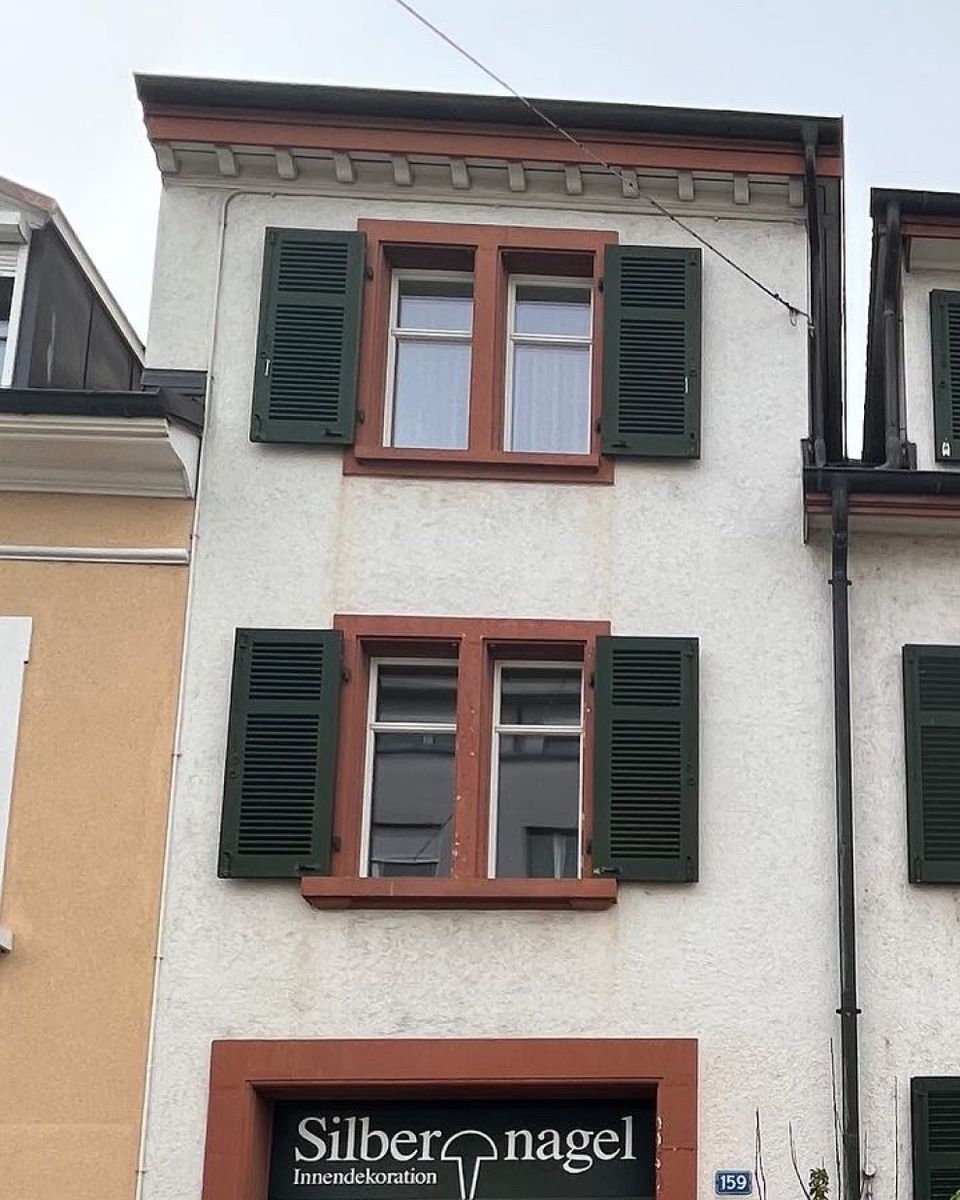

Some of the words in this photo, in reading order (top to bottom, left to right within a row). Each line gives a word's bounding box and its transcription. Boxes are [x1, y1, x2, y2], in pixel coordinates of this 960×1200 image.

[295, 1116, 442, 1162] Silber
[503, 1115, 637, 1174] nagel
[293, 1167, 437, 1185] Innendekoration
[720, 1174, 747, 1190] 159
